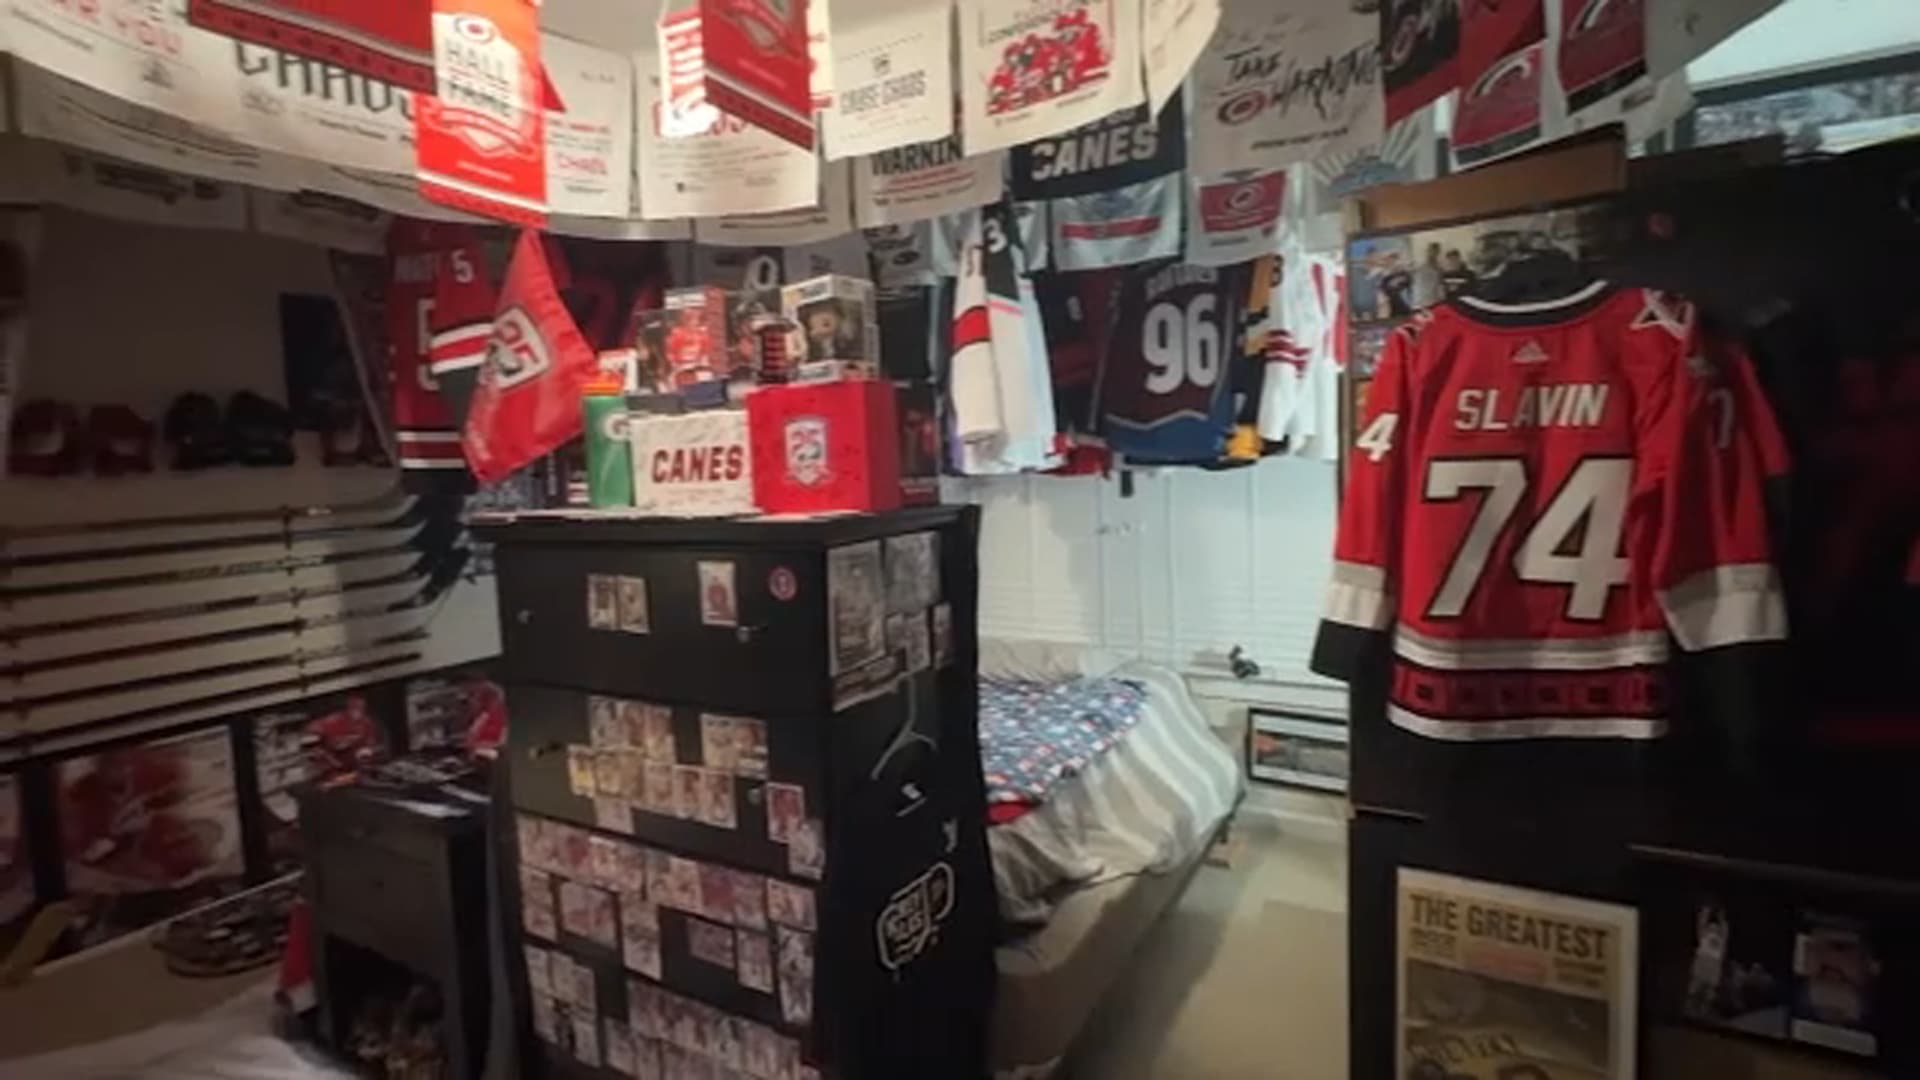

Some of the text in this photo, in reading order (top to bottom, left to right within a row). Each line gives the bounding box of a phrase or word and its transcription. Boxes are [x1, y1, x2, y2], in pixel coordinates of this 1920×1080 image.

[1031, 121, 1159, 182] CANES
[452, 250, 474, 283] 5
[1142, 292, 1221, 394] 96
[1454, 383, 1609, 431] SLAVIN
[651, 445, 744, 484] CANES
[1356, 413, 1399, 462] 4
[1425, 456, 1636, 620] 74
[1409, 893, 1458, 931] THE
[1466, 904, 1609, 960] GREATEST
